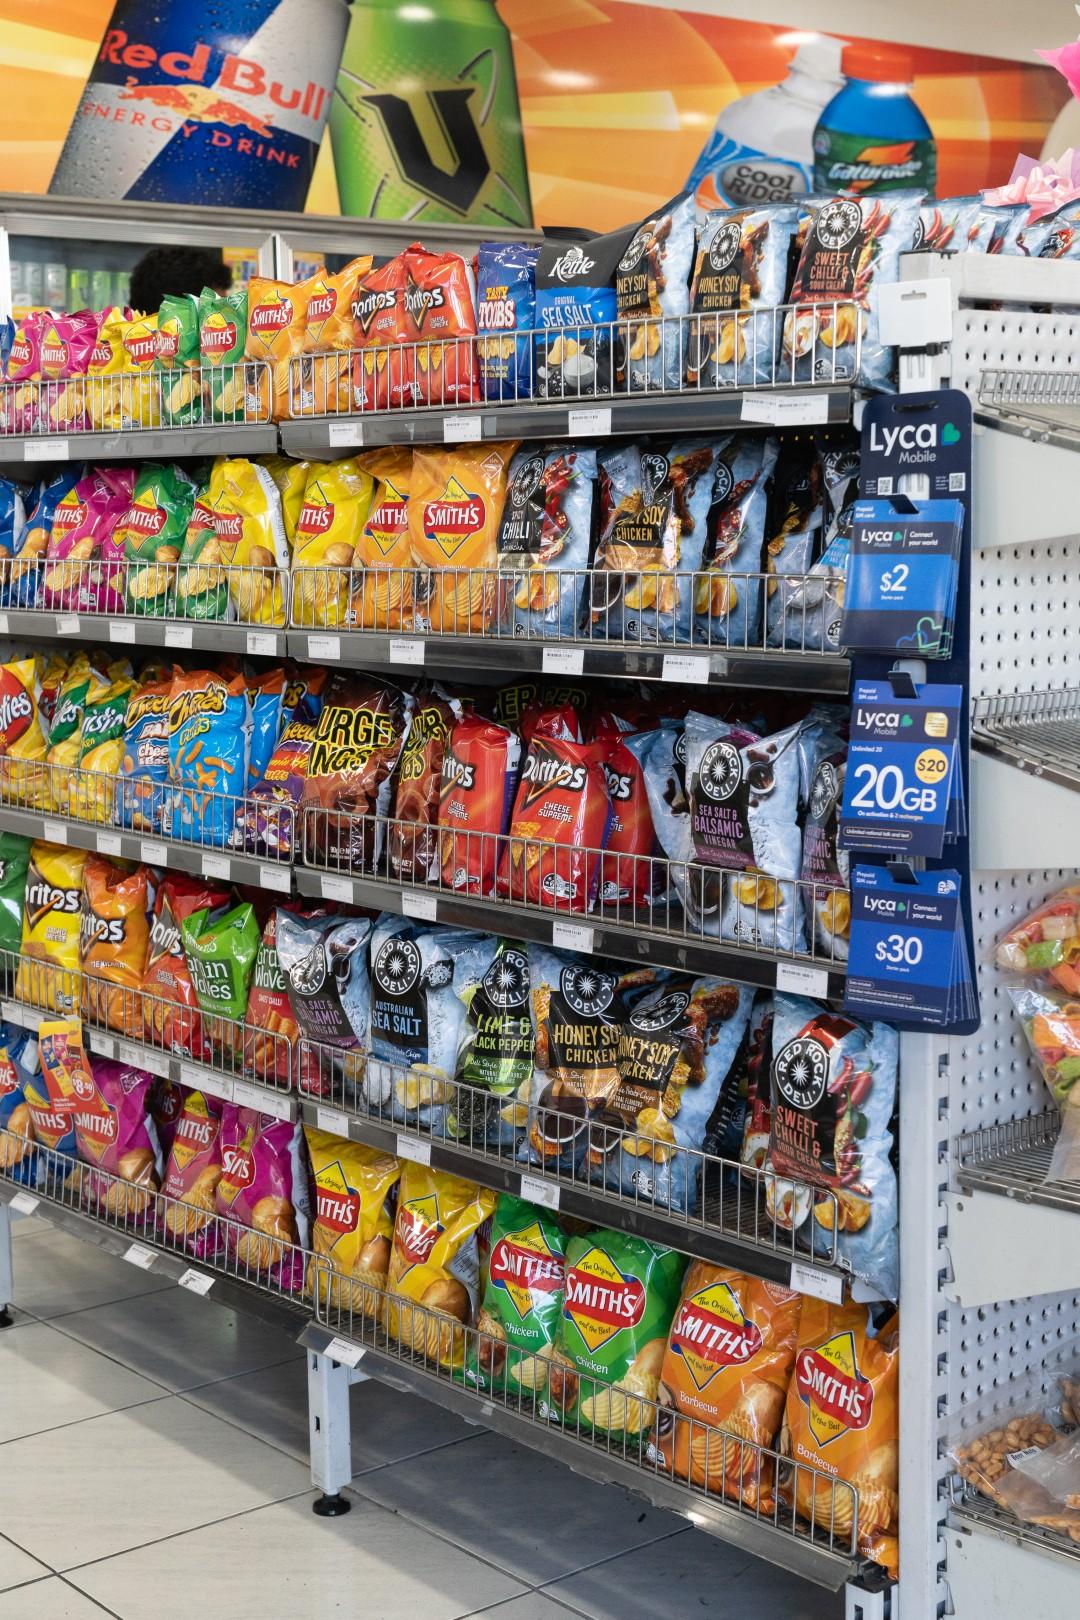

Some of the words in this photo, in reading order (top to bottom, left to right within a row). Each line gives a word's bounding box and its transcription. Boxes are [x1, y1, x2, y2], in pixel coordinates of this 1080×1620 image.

[100, 29, 211, 83] Red
[220, 54, 328, 122] Bull
[83, 104, 198, 138] ENERGY
[212, 131, 300, 169] DRINK
[828, 157, 924, 183] Gatorade
[822, 234, 848, 246] DELI
[548, 255, 595, 283] Kettle
[713, 253, 732, 267] DELI
[814, 252, 849, 265] SWEET
[810, 266, 839, 279] CHILLI
[841, 265, 849, 278] &
[486, 286, 509, 300] TASTY
[617, 276, 634, 295] NEY
[634, 274, 648, 290] SOY
[698, 278, 723, 294] HONEY
[725, 275, 740, 292] SOY
[351, 290, 396, 319] Doritos
[404, 287, 442, 312] Doritos
[703, 296, 732, 308] CHICKEN
[251, 305, 288, 327] SMITH'S
[478, 300, 515, 328] TOOBS
[542, 306, 567, 328] SEA
[568, 304, 593, 326] SALT
[199, 327, 233, 347] SMITH'S
[41, 345, 66, 363] SMITH'S
[869, 423, 938, 457] Lyca
[898, 450, 938, 464] Mobile
[300, 507, 331, 527] ITH'S
[426, 502, 480, 527] SMITH'S
[644, 506, 667, 526] SOY
[502, 521, 531, 540] CHILLI
[616, 527, 653, 541] CHICKEN
[861, 528, 893, 545] Lyca
[909, 531, 934, 539] Connect
[908, 540, 921, 548] your
[922, 539, 939, 547] world
[880, 563, 909, 592] $2
[315, 705, 391, 748] URGE
[856, 709, 901, 730] Lyca
[873, 726, 898, 736] Mobile
[851, 745, 875, 753] Unlimited
[306, 742, 373, 778] INGS
[702, 747, 720, 775] RED
[720, 744, 739, 783] ROCK
[917, 758, 946, 773] $20
[522, 755, 587, 790] Doritos
[705, 783, 732, 797] DELI
[850, 763, 938, 813] 20GB
[450, 799, 466, 812] CHEESE
[538, 807, 573, 824] SUPREME
[543, 801, 571, 814] CHEESE
[698, 804, 713, 817] SEA
[715, 805, 732, 820] SALT
[732, 810, 738, 821] &
[694, 815, 744, 839] BALSAMIC
[703, 835, 737, 851] VINEGAR
[856, 871, 876, 879] Prepaid
[25, 883, 80, 911] ritos
[864, 895, 897, 912] Lyca
[911, 912, 925, 921] your
[926, 913, 943, 922] world
[912, 904, 938, 913] Connect
[378, 942, 394, 968] RED
[396, 940, 418, 973] ROCK
[874, 934, 923, 965] $30
[255, 965, 287, 990] Wave
[506, 954, 530, 987] ROCK
[381, 976, 409, 992] DELI
[565, 965, 583, 991] RED
[574, 998, 604, 1014] DELI
[492, 990, 524, 1005] DELI
[375, 1000, 415, 1017] AUSTRALIAN
[372, 1010, 390, 1030] SEA
[393, 1015, 422, 1037] SALT
[477, 1013, 515, 1036] LIME
[519, 1015, 532, 1037] &
[635, 1014, 667, 1029] DELI
[499, 1038, 535, 1052] PEPPER
[555, 1023, 598, 1046] HONEY
[566, 1048, 617, 1063] CHICKEN
[646, 1041, 678, 1067] SOY
[777, 1043, 802, 1073] RED
[805, 1041, 825, 1087] ROCK
[783, 1083, 814, 1106] DELI
[177, 1118, 213, 1144] MITH'S
[776, 1105, 818, 1139] SWEET
[774, 1121, 810, 1152] CHILLI
[811, 1138, 822, 1158] &
[168, 1174, 179, 1186] Salt
[325, 1176, 345, 1193] Original
[317, 1197, 356, 1226] ITH'S
[523, 1235, 545, 1253] Original
[494, 1243, 565, 1280] SMITH'S
[581, 1261, 594, 1272] The
[593, 1262, 617, 1281] Original
[565, 1271, 638, 1318] SMITH'S
[697, 1295, 711, 1308] The
[712, 1300, 740, 1322] Original
[504, 1321, 540, 1340] Chicken
[578, 1319, 589, 1329] and
[588, 1323, 598, 1334] the
[597, 1325, 612, 1336] Best
[673, 1306, 755, 1361] SMITH'S
[822, 1346, 835, 1359] The
[575, 1354, 609, 1376] Chicken
[799, 1355, 867, 1420] SMITH'S
[679, 1390, 719, 1417] Barbecue
[817, 1416, 828, 1428] the
[828, 1419, 842, 1432] Best
[797, 1442, 840, 1475] Barbecue
[1010, 1451, 1025, 1462] Beer
[1023, 1447, 1038, 1457] Nuts
